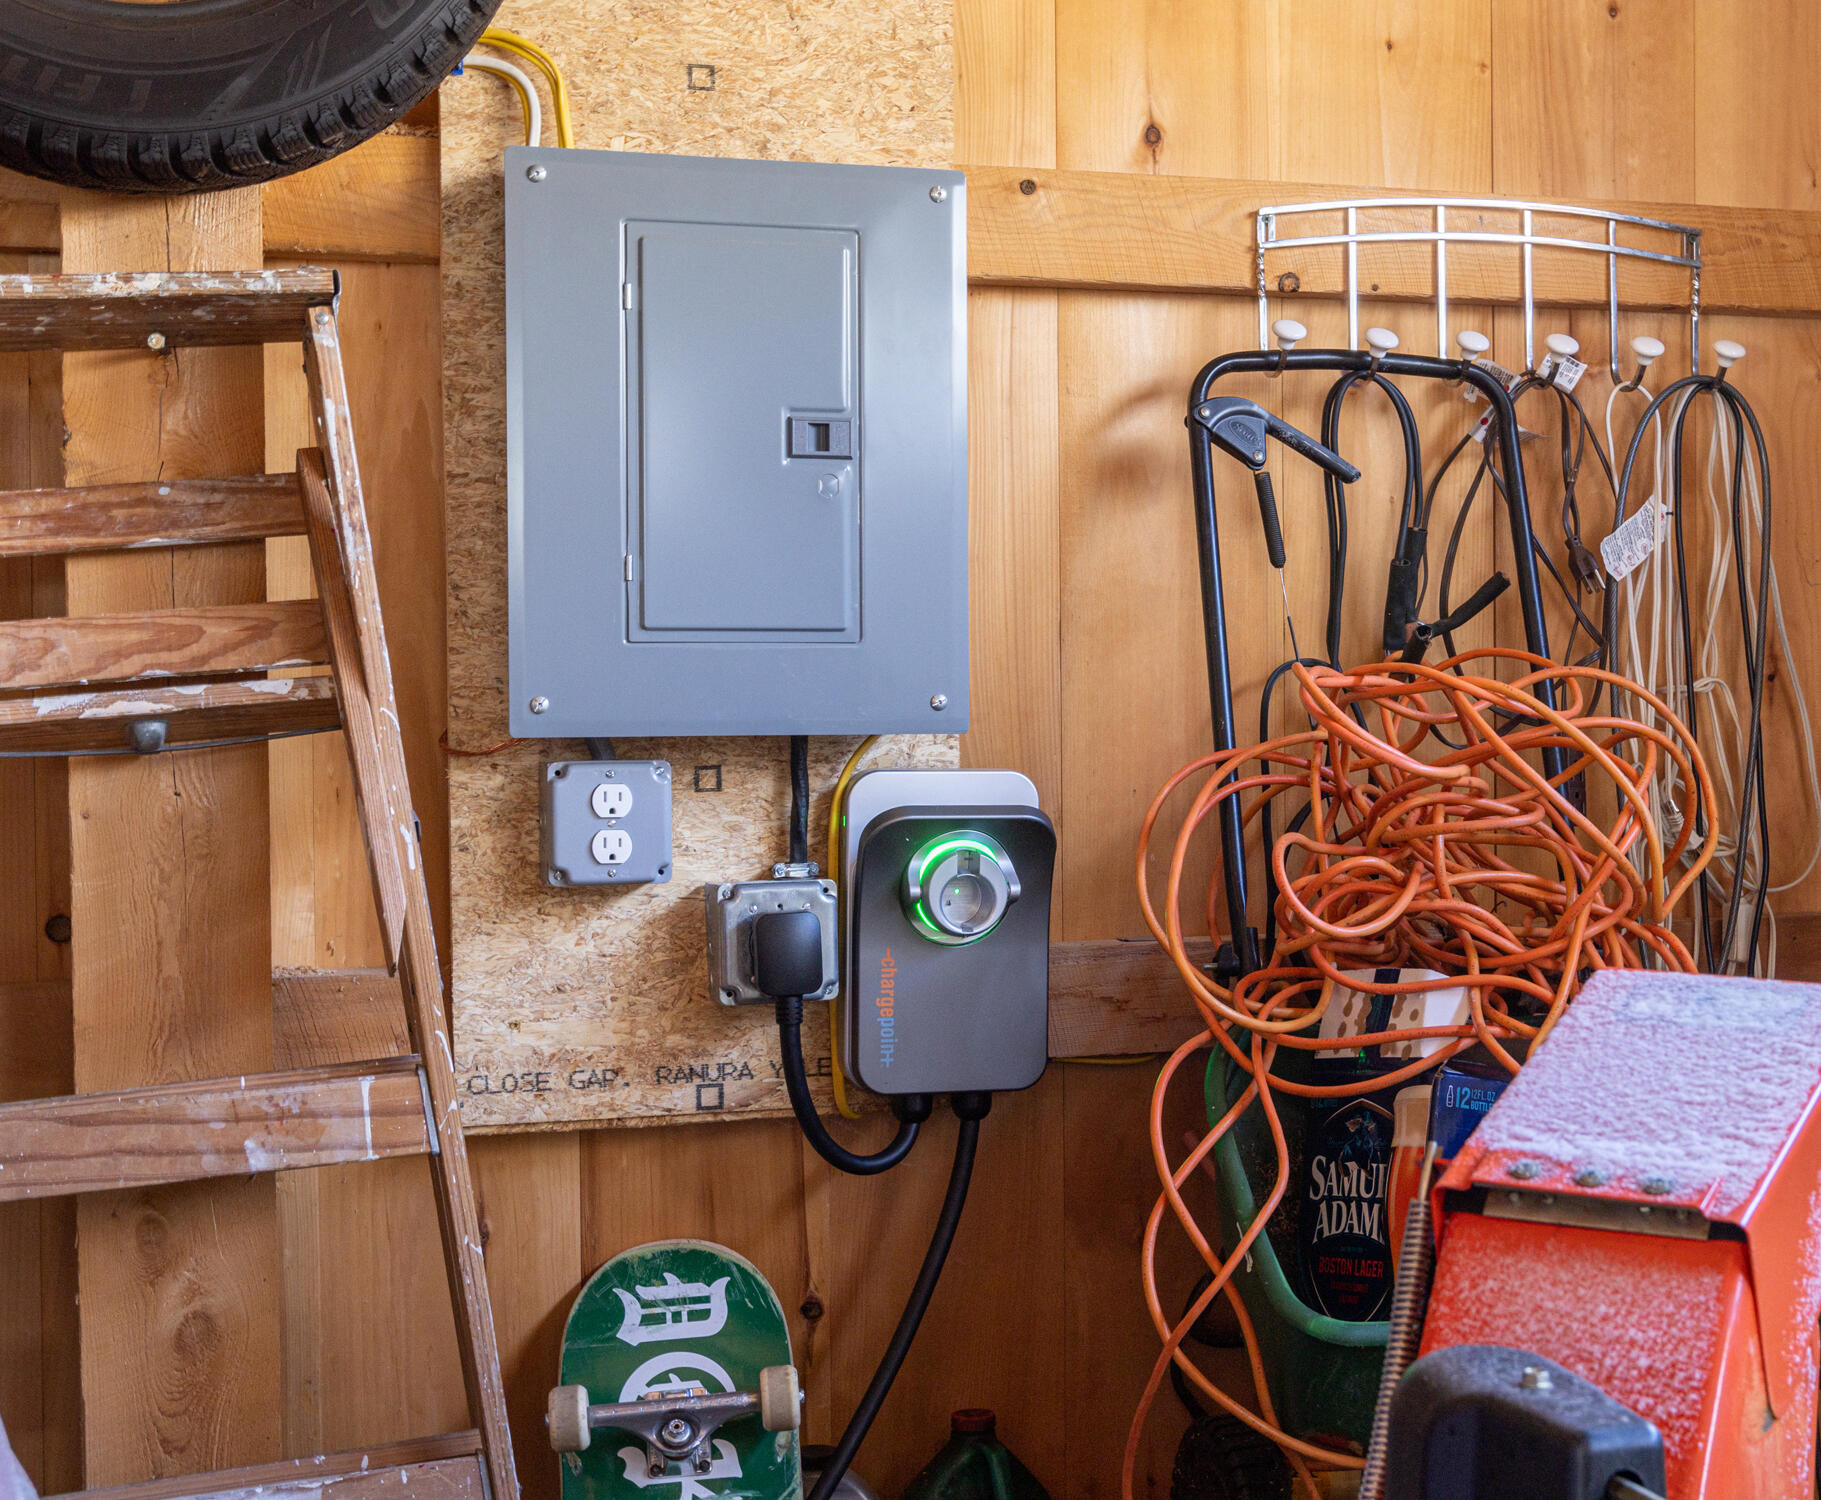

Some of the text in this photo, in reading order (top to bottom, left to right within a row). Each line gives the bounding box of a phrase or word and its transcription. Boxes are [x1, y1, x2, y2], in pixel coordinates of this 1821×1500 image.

[466, 1072, 552, 1095] CLOSE
[568, 1068, 630, 1090] GAP.
[655, 1061, 755, 1085] RANURA
[1455, 1086, 1471, 1110] 12
[1318, 1256, 1385, 1279] BOSTON LAGER
